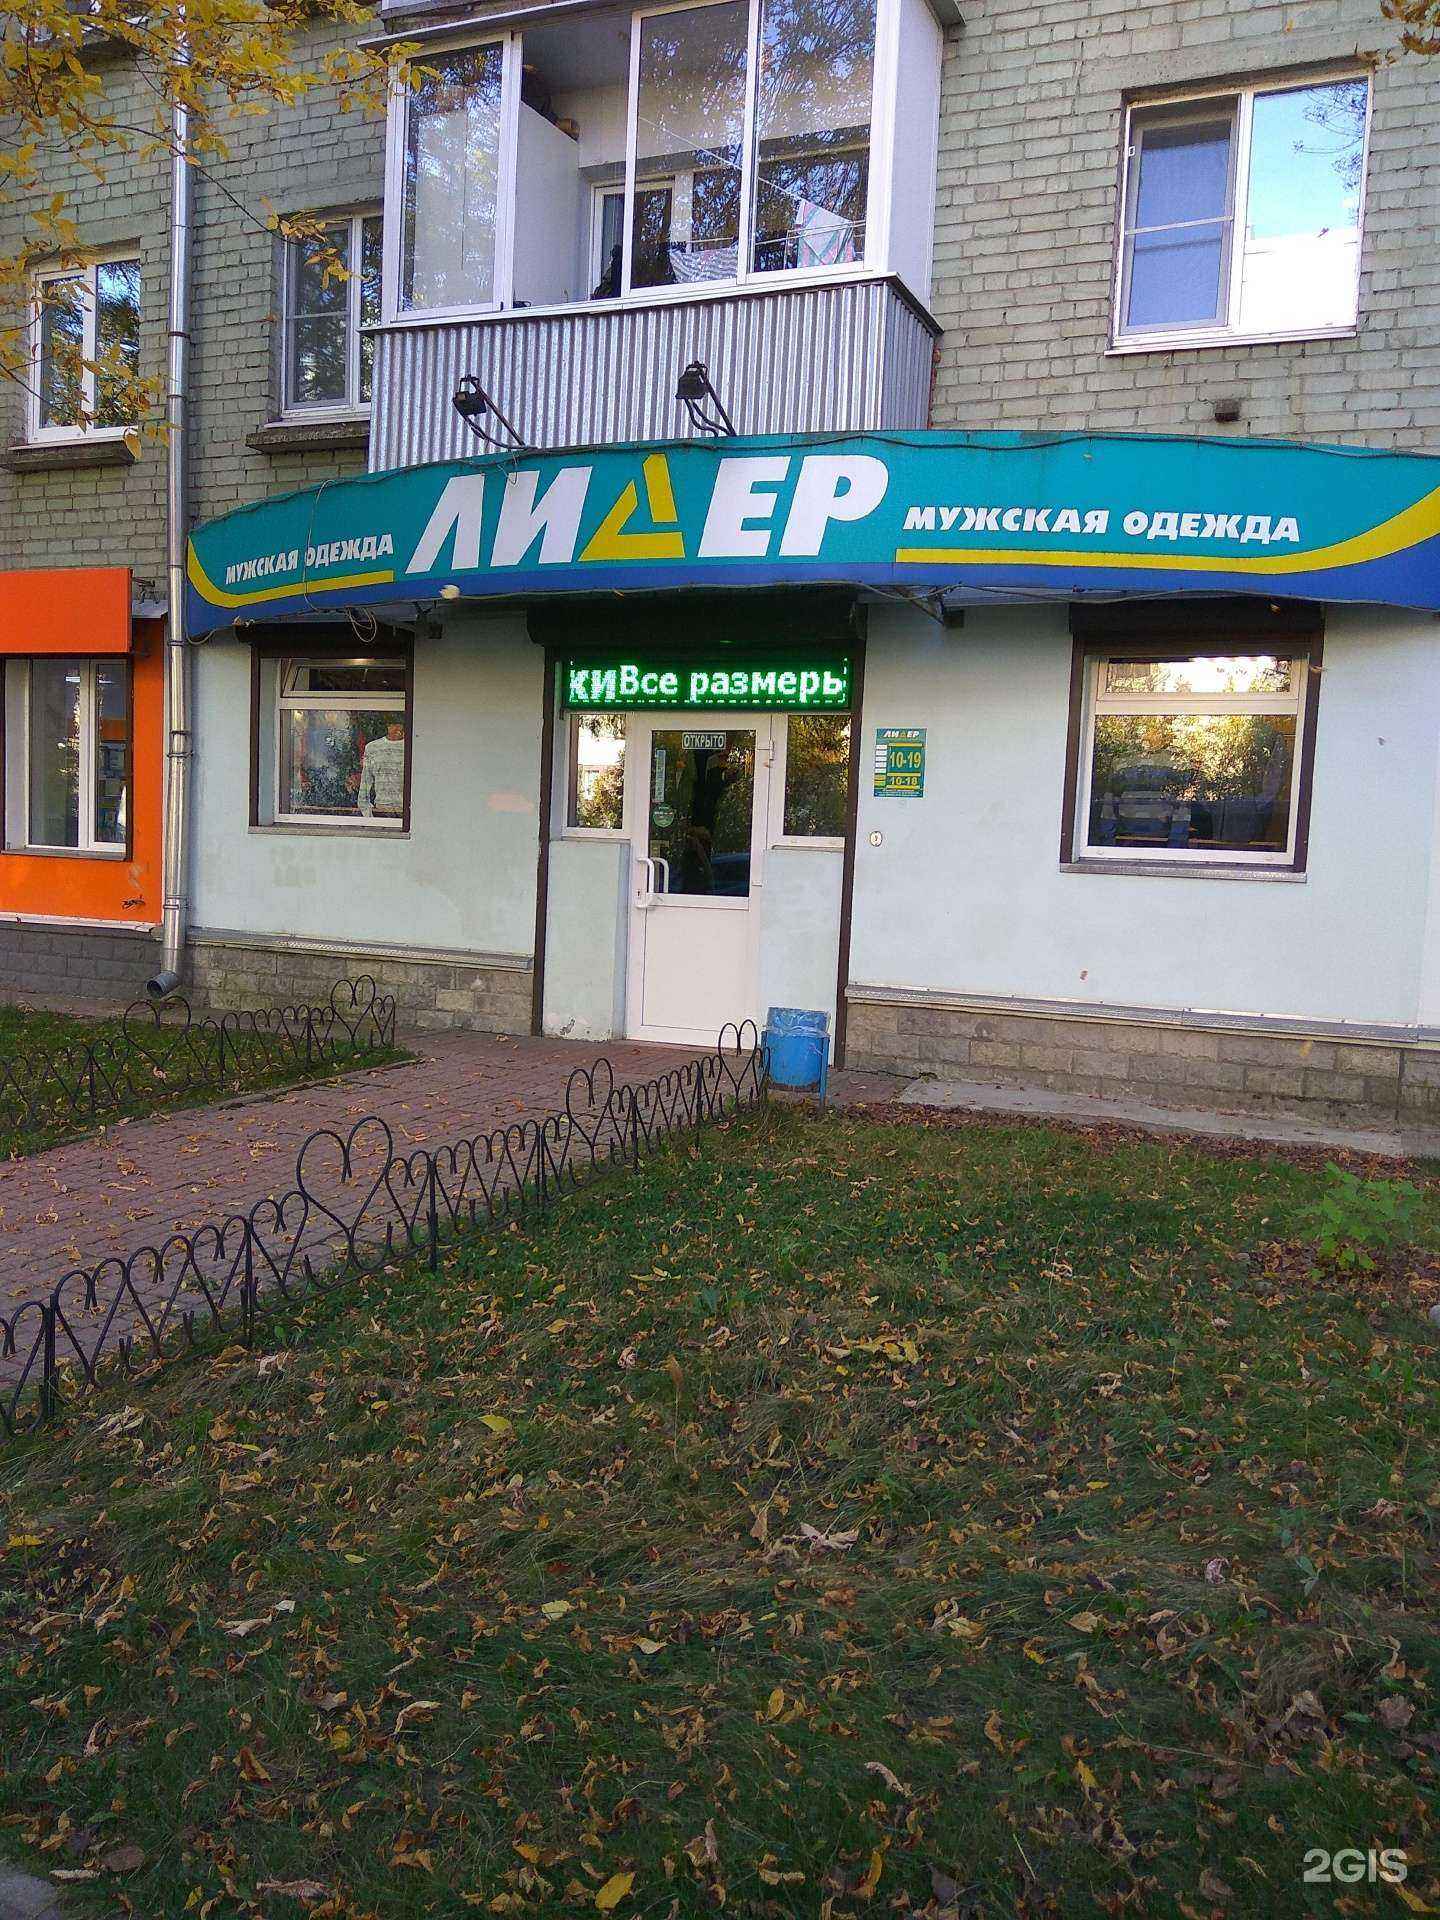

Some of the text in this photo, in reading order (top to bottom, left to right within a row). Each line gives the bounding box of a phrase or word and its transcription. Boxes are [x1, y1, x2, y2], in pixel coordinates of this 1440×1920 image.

[404, 453, 889, 573] ЛИДЕР
[903, 505, 1300, 545] МУЖСКАЯ ОДЕЖДА
[225, 533, 394, 585] МУЖСКАЯ ОДЕЖДА
[683, 734, 725, 748] ОТКРЫТО
[889, 751, 921, 768] 10-19
